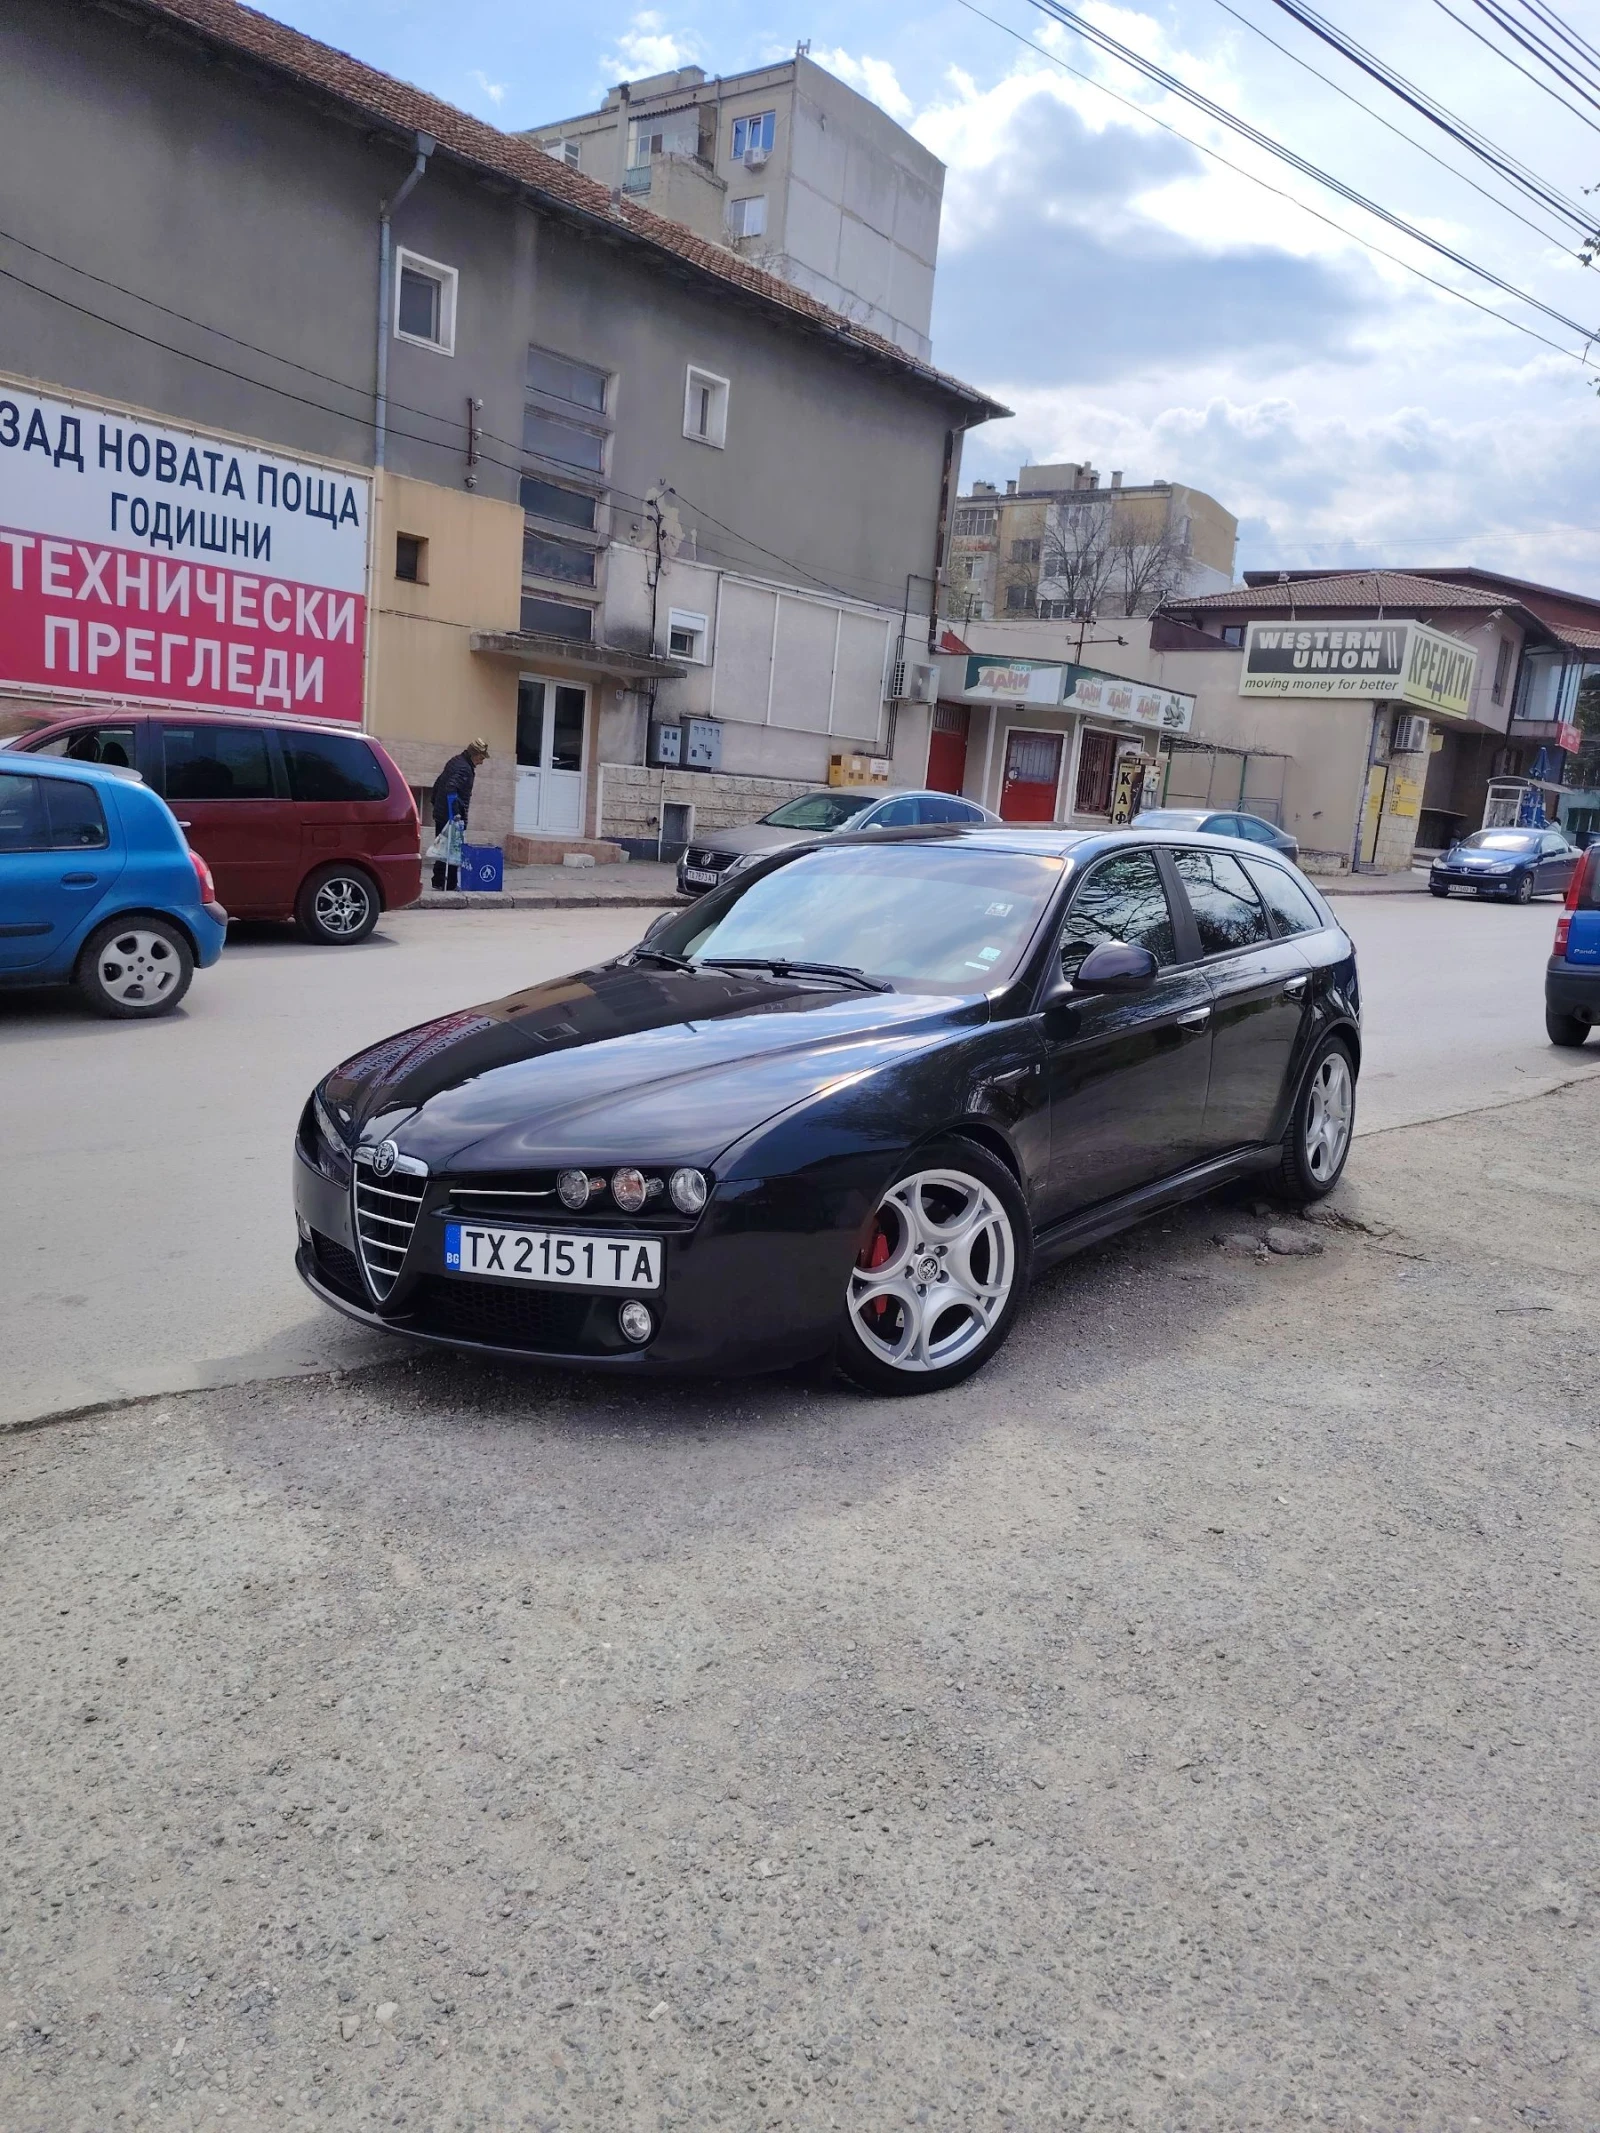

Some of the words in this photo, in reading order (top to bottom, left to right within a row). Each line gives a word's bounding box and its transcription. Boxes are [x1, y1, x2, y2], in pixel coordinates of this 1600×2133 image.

[0, 401, 84, 473] ЗАД
[99, 424, 246, 500] НОВАТА
[257, 464, 359, 530] ПОЩА
[111, 492, 271, 562] ГОДИШНИ
[0, 532, 356, 645] ТЕХНИЧЕСКИ
[44, 614, 324, 709] ПРЕГЛЕДИ
[1259, 631, 1382, 649] WESTERN
[1293, 651, 1380, 669] UNION
[1408, 635, 1475, 702] КРЕДИТИ
[1244, 678, 1289, 691] moving
[1293, 680, 1334, 692] money
[1338, 678, 1356, 690] for
[1359, 679, 1400, 691] better
[446, 1252, 460, 1264] BG
